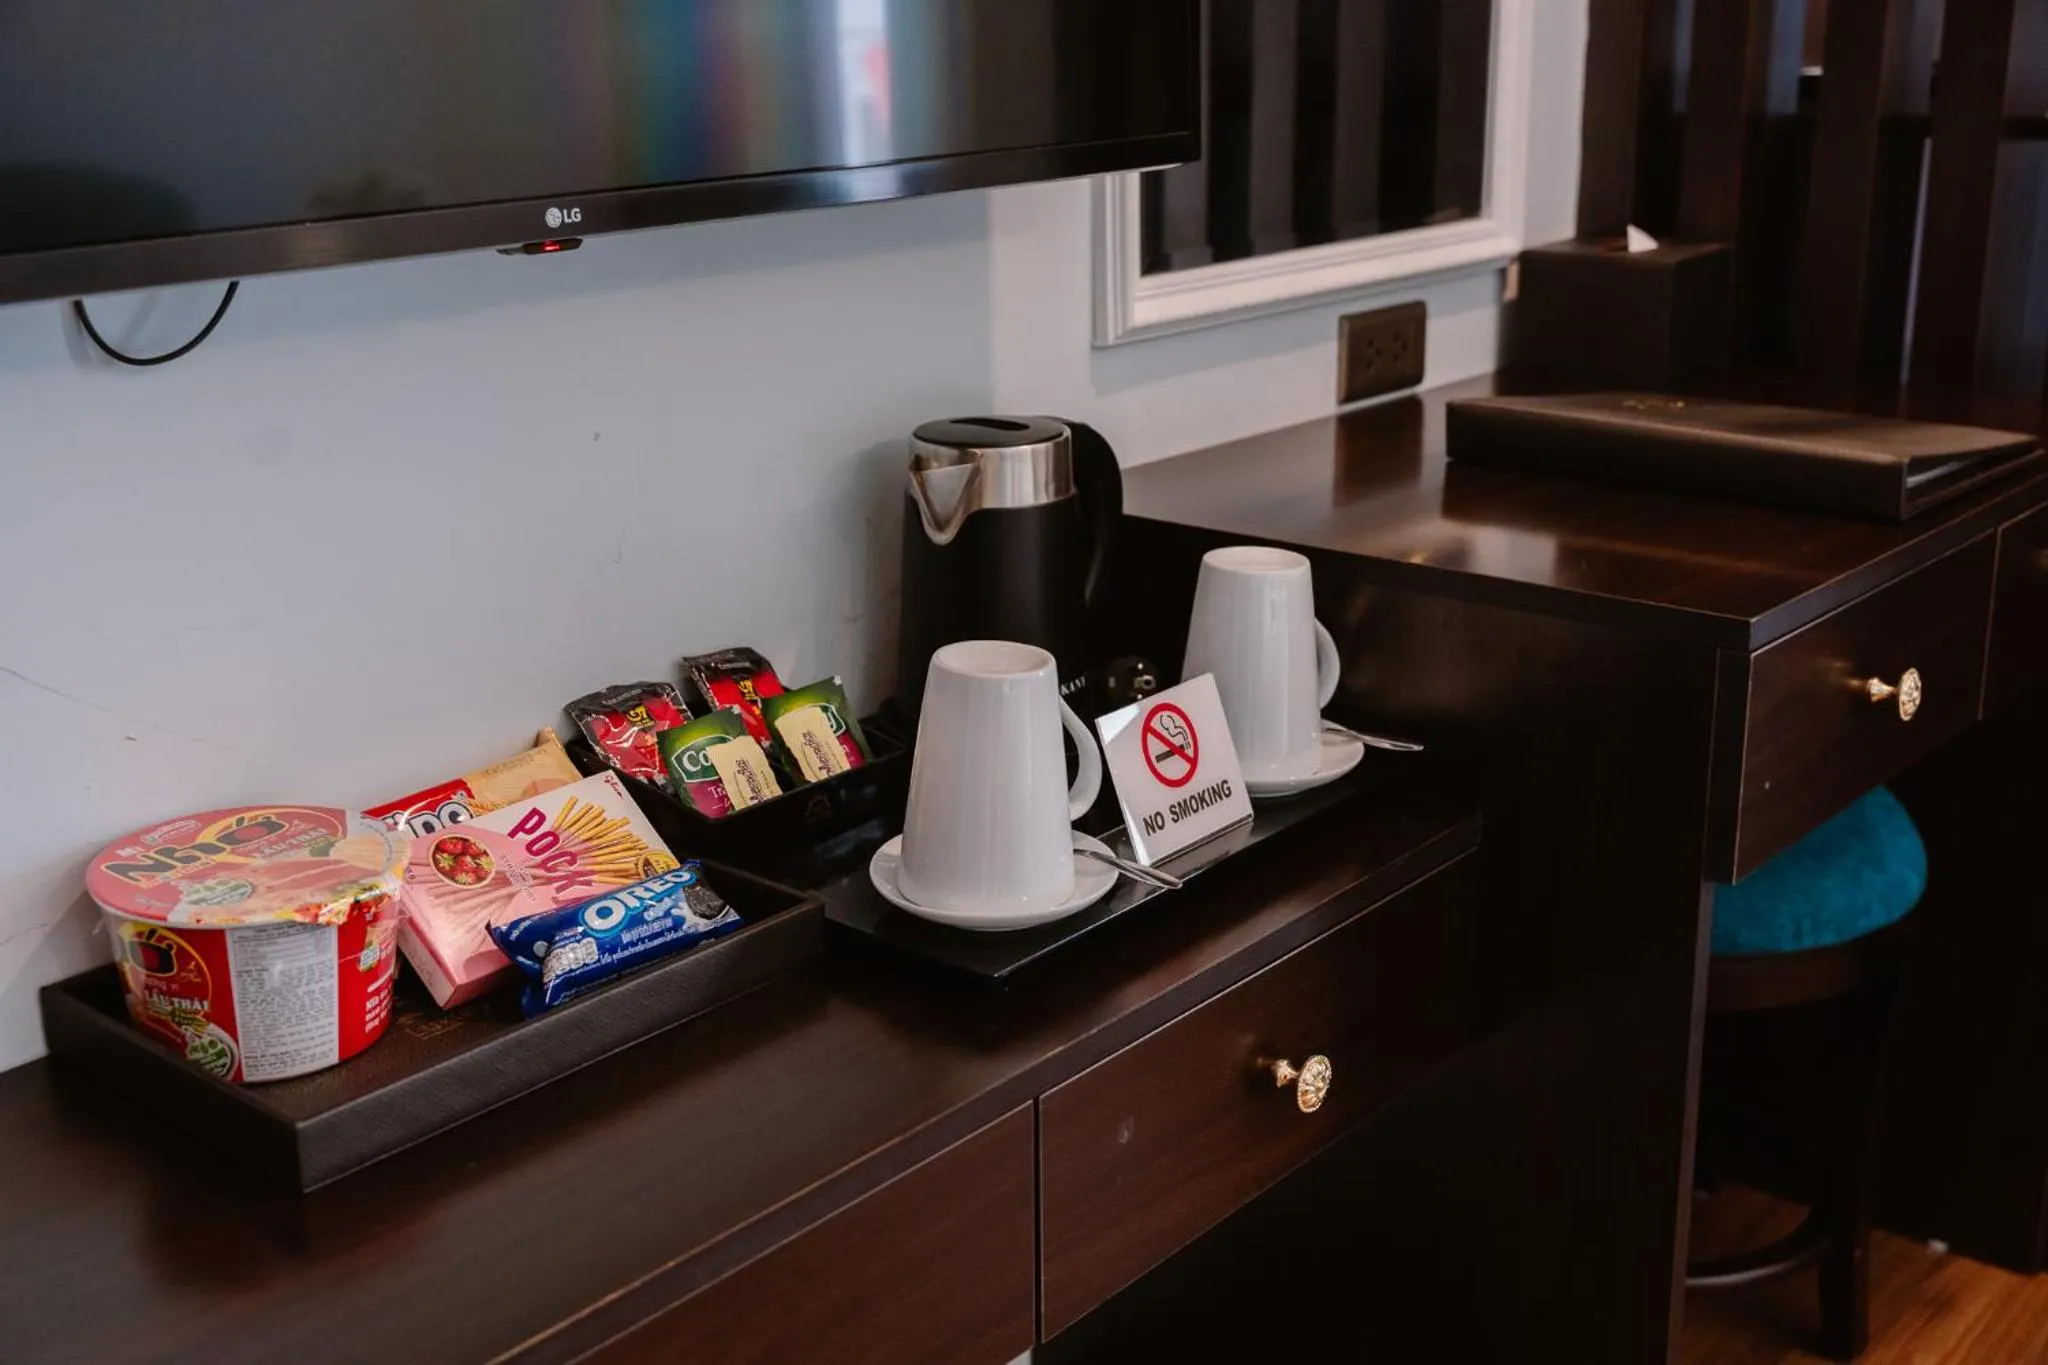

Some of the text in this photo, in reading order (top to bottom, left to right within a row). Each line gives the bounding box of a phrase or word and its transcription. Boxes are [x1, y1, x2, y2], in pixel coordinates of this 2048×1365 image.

[562, 207, 582, 223] LG
[627, 704, 650, 723] G7
[682, 749, 712, 772] Co
[1143, 779, 1233, 836] NO SMOKING
[583, 871, 692, 931] OREO
